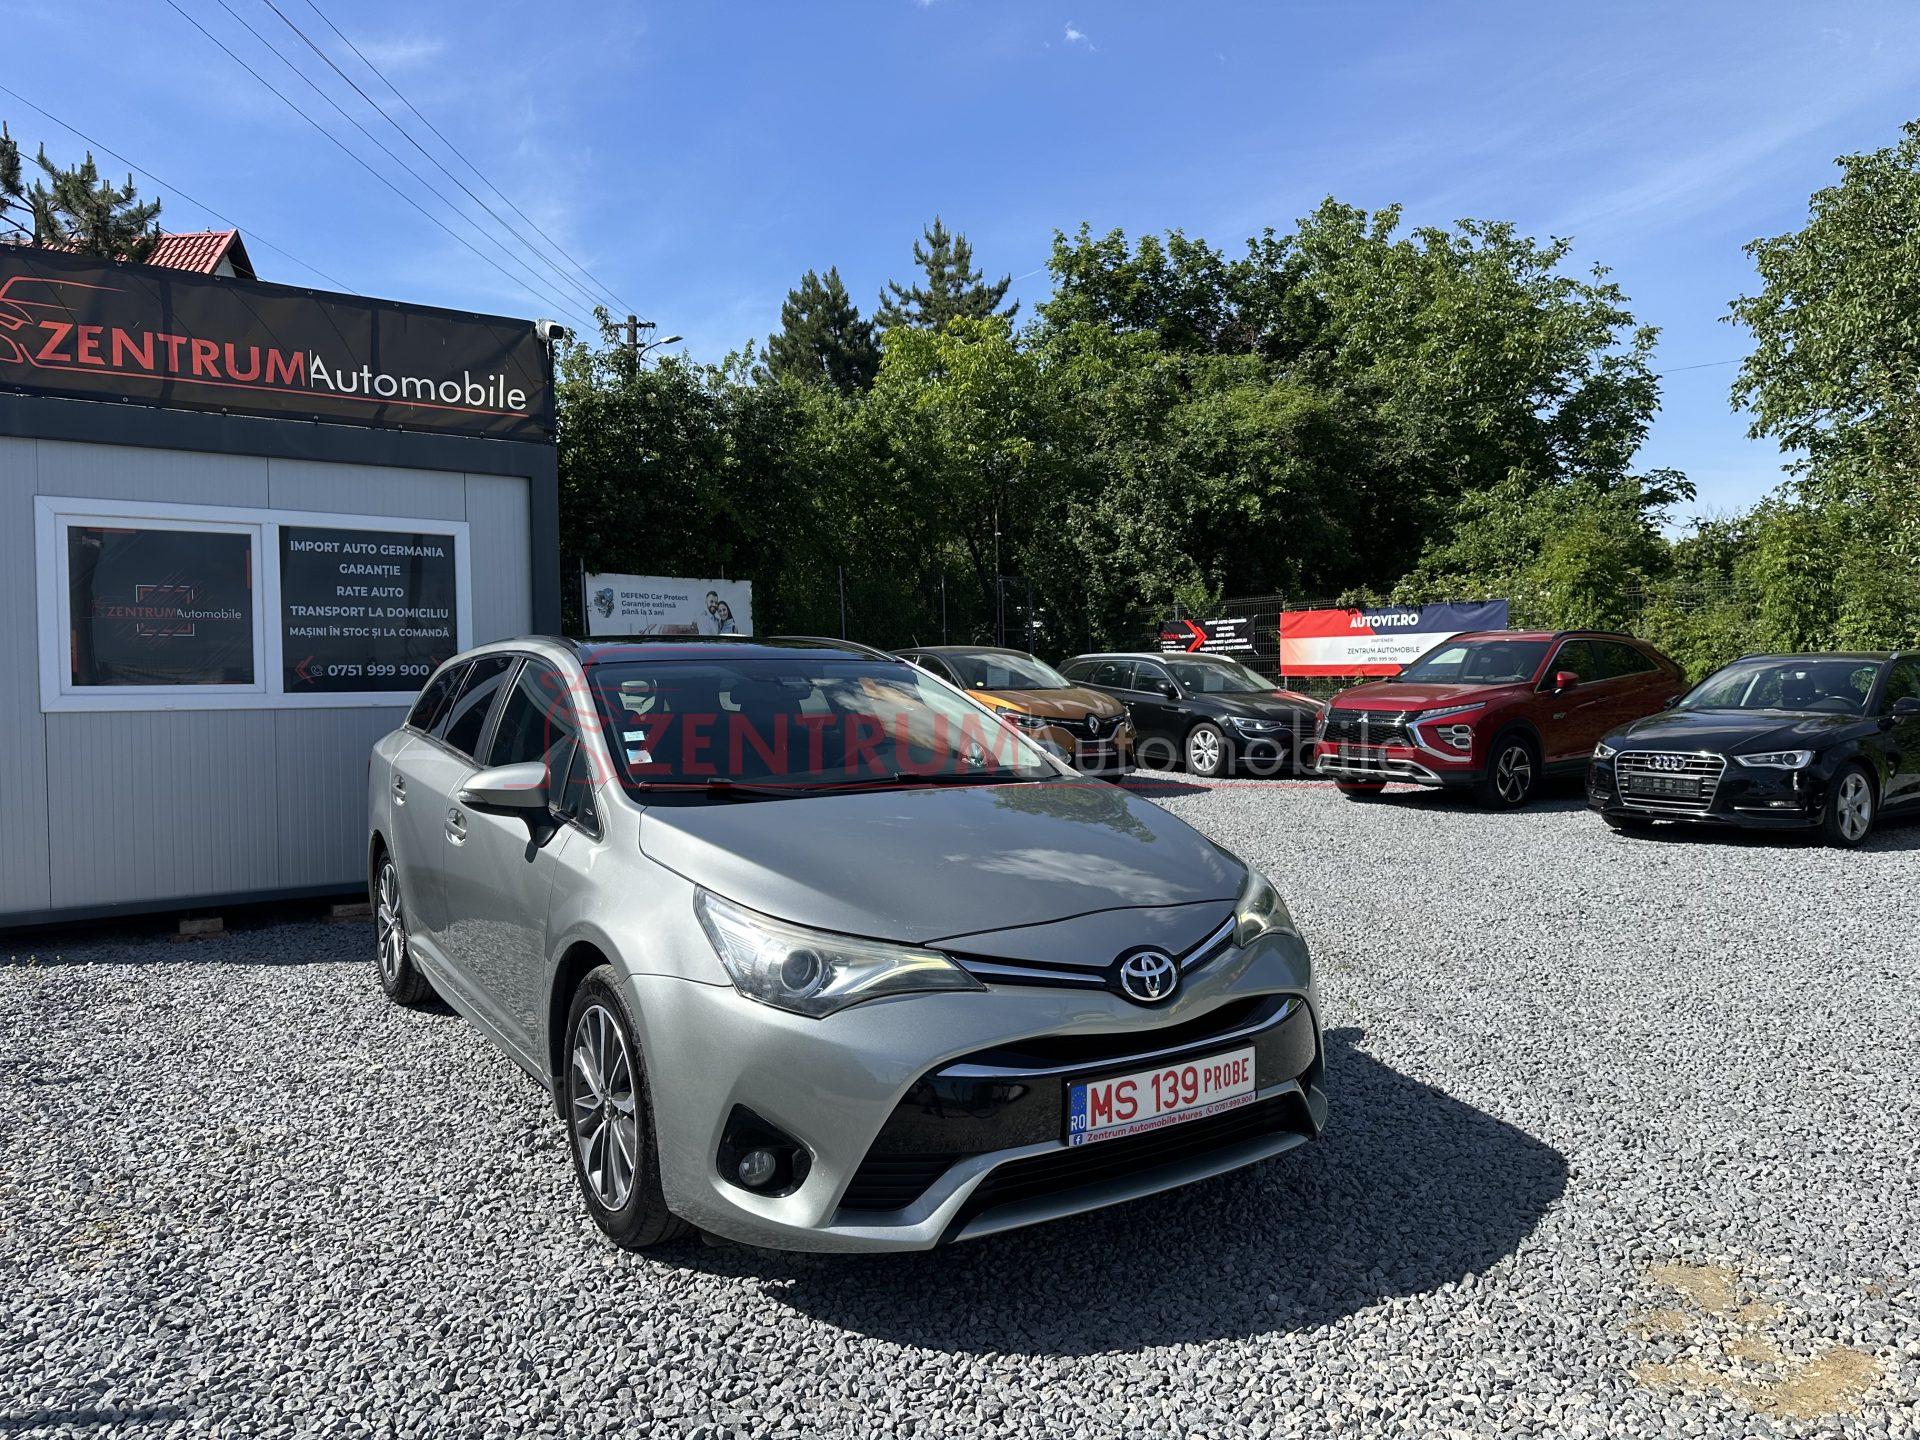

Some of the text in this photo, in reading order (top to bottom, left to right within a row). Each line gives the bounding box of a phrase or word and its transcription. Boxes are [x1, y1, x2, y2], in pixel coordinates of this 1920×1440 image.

[36, 320, 528, 410] ZENTRUM Automobile
[290, 541, 444, 558] IMPORT AUTO GERMANIA
[339, 564, 401, 578] GARANȚIE
[336, 586, 404, 597] RATE AUTO
[620, 592, 650, 600] DEFEND
[107, 606, 242, 619] ZENTRUM Automobile
[290, 605, 449, 619] TRANSPORT LA DOMICILIU
[640, 608, 647, 616] la
[1350, 613, 1419, 629] AUTOVIT.RO
[289, 626, 450, 639] MAȘINI ÎN STOC ȘI LA COMANDĂ
[1377, 646, 1420, 654] AUTOMOBILE
[327, 664, 430, 677] 0751 999 900
[1090, 1057, 1250, 1127] MS 139 PROBE
[1070, 1114, 1086, 1132] RO
[1086, 1128, 1127, 1142] Zentrum
[1128, 1116, 1177, 1134] Automobile
[1178, 1110, 1203, 1123] Mures
